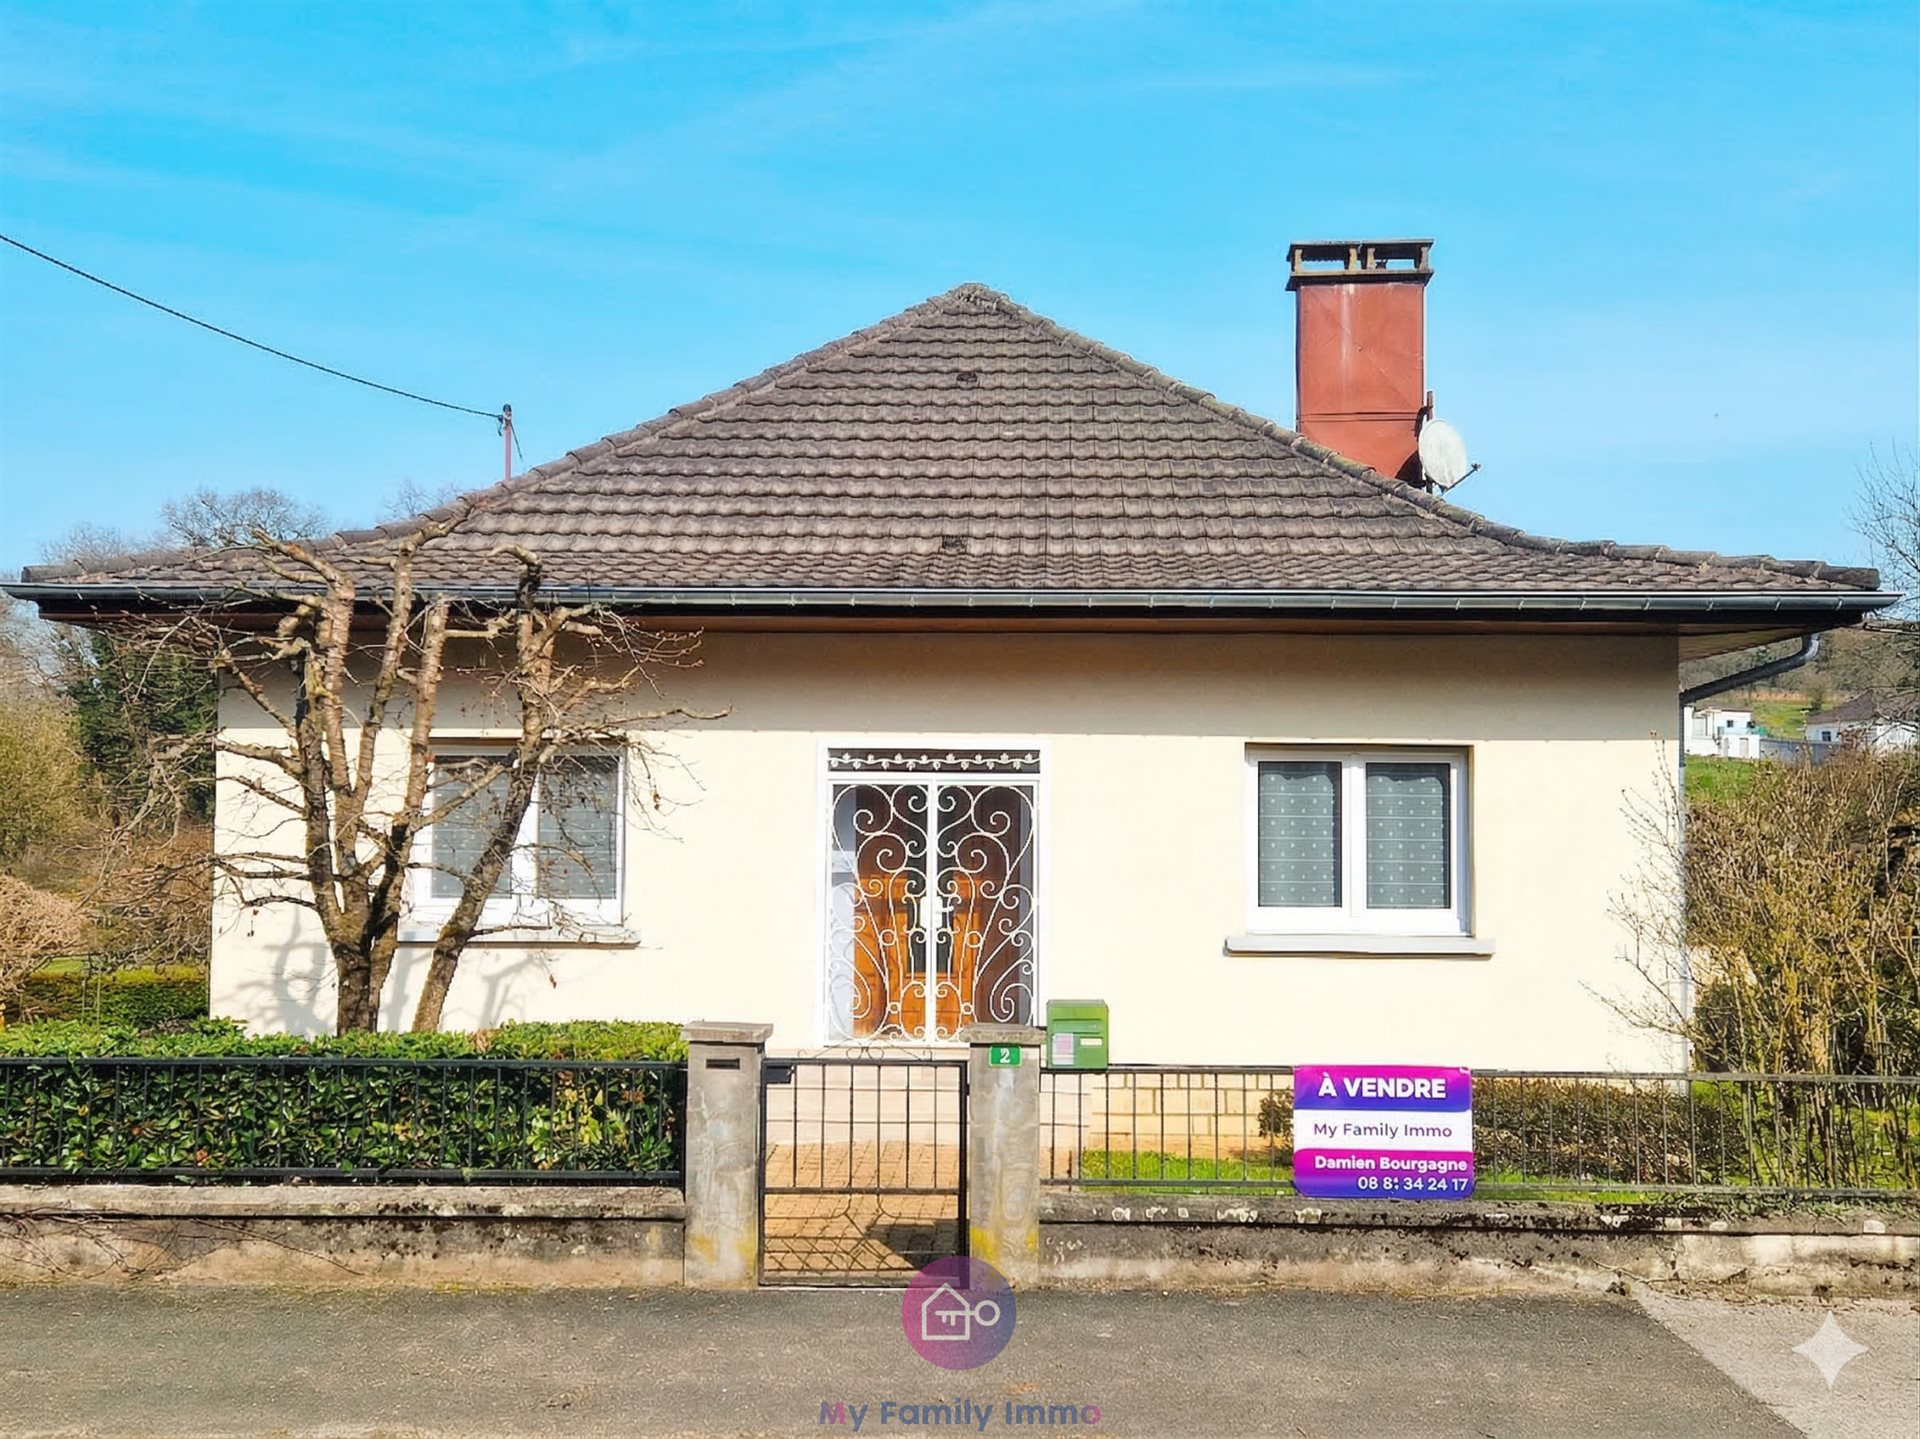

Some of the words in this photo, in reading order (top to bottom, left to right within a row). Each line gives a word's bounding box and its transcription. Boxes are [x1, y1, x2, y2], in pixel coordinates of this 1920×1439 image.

[1000, 1048, 1011, 1063] 2
[1318, 1072, 1337, 1097] À
[1343, 1077, 1446, 1099] VENDRE
[1314, 1123, 1337, 1138] My
[1343, 1122, 1399, 1139] Family
[1404, 1124, 1452, 1138] Immo
[1314, 1155, 1376, 1170] Damien
[1380, 1156, 1468, 1174] Bourgagne
[1358, 1176, 1379, 1190] 08
[1404, 1177, 1424, 1190] 34
[1427, 1177, 1447, 1191] 24
[1452, 1178, 1468, 1191] 17
